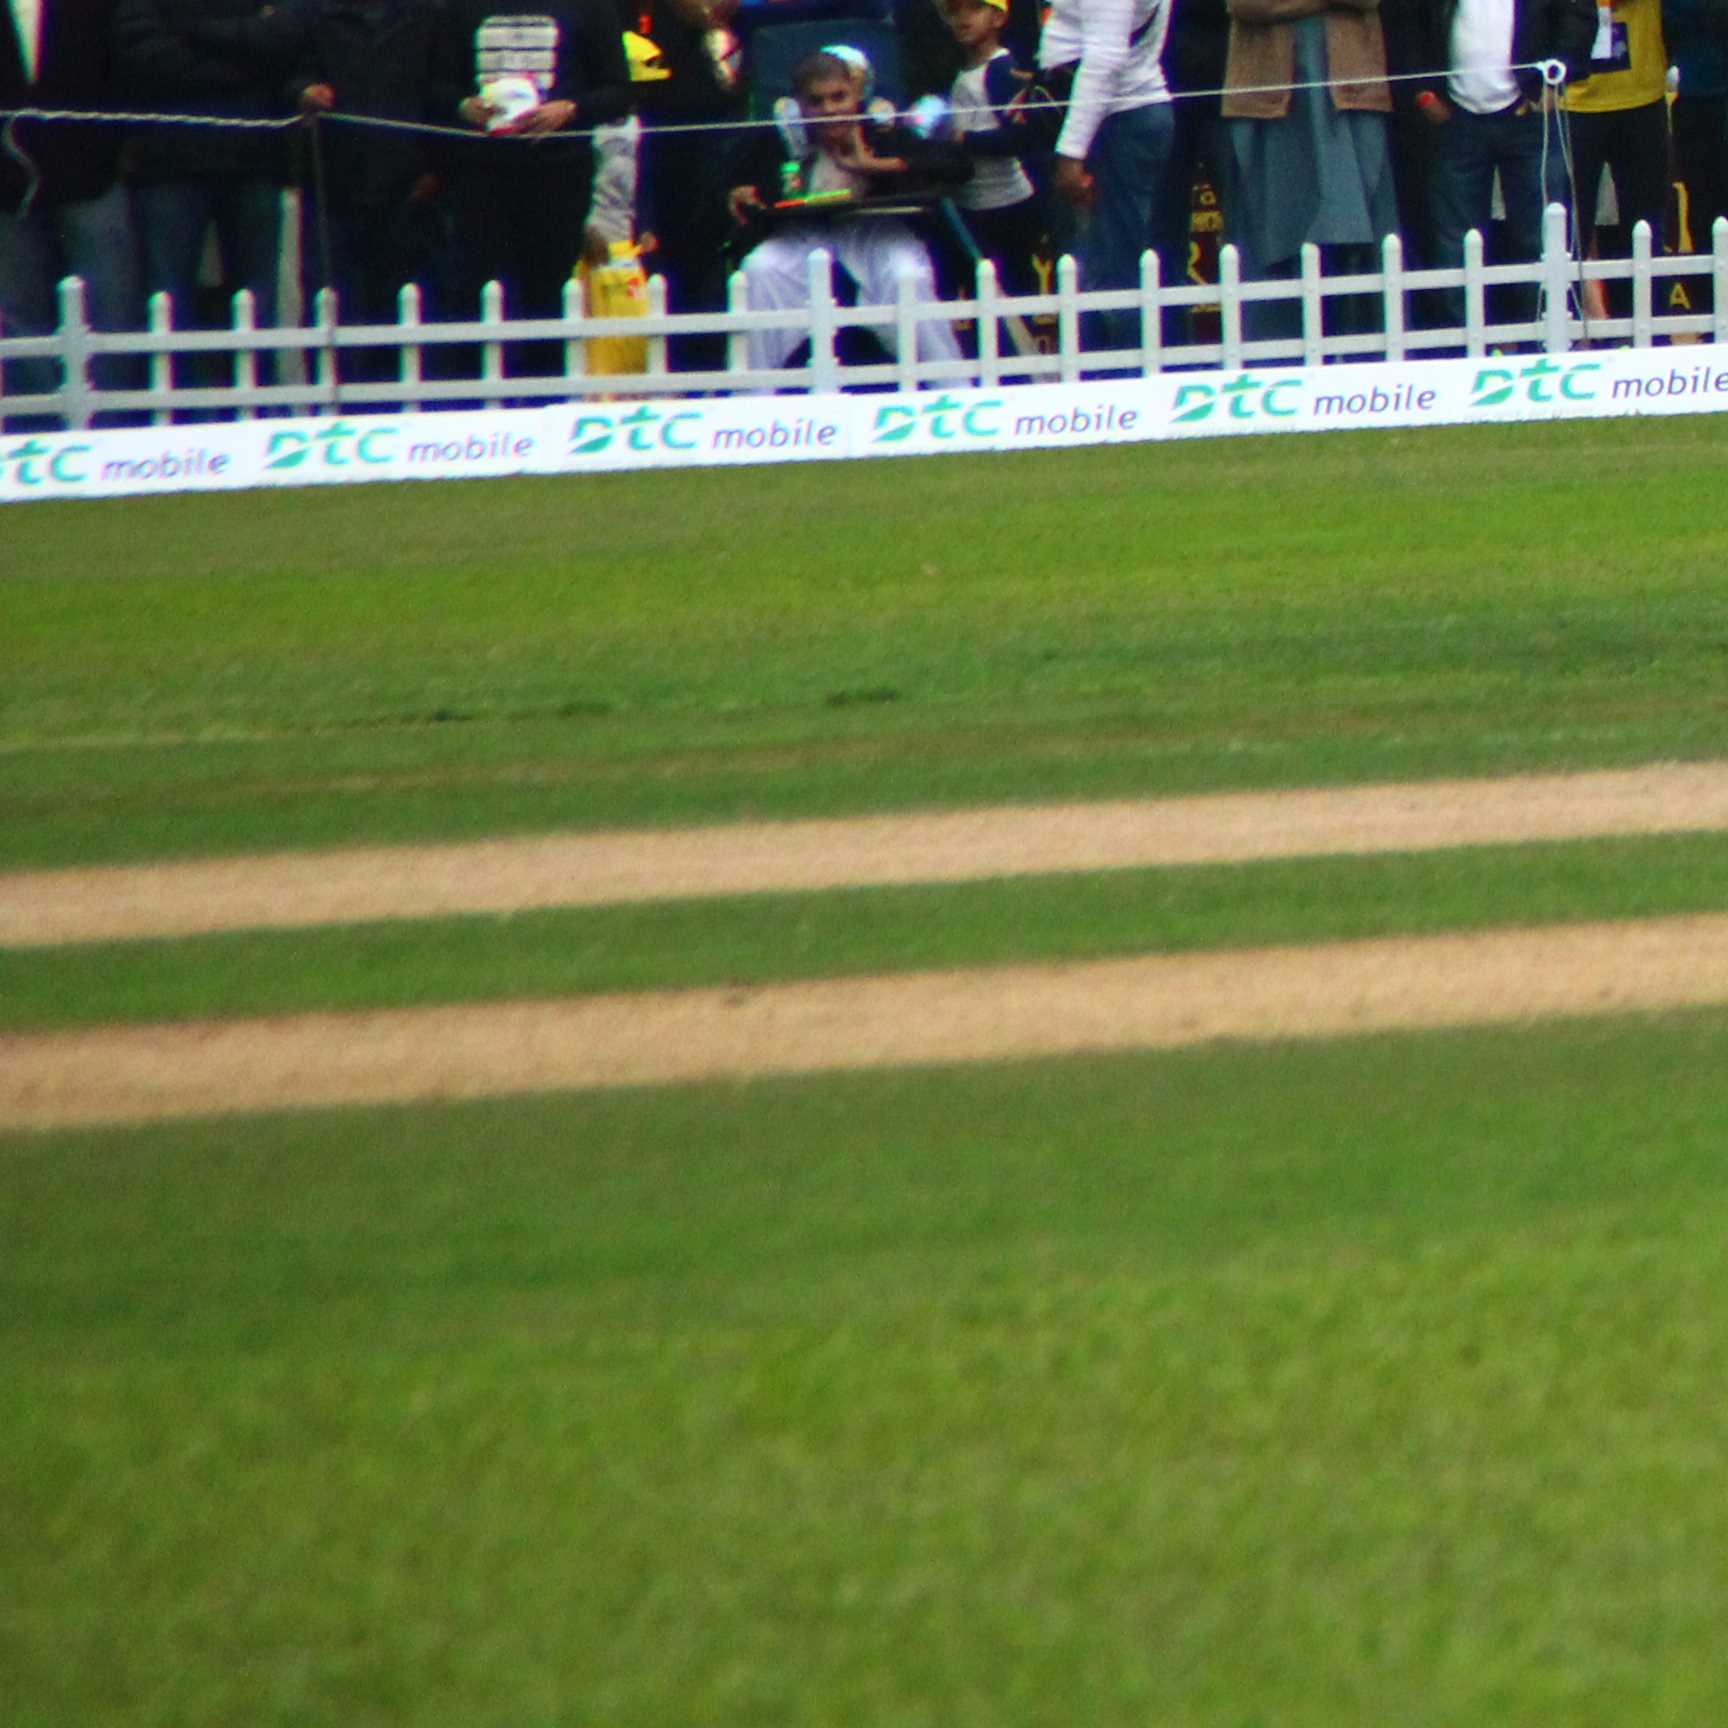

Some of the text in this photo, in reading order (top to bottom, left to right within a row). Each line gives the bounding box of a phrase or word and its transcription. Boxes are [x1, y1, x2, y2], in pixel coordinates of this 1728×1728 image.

[1313, 383, 1437, 416] mobile
[713, 417, 838, 449] mobile
[1013, 403, 1139, 437] mobile
[408, 431, 537, 463] mobile
[101, 446, 231, 482] mobile
